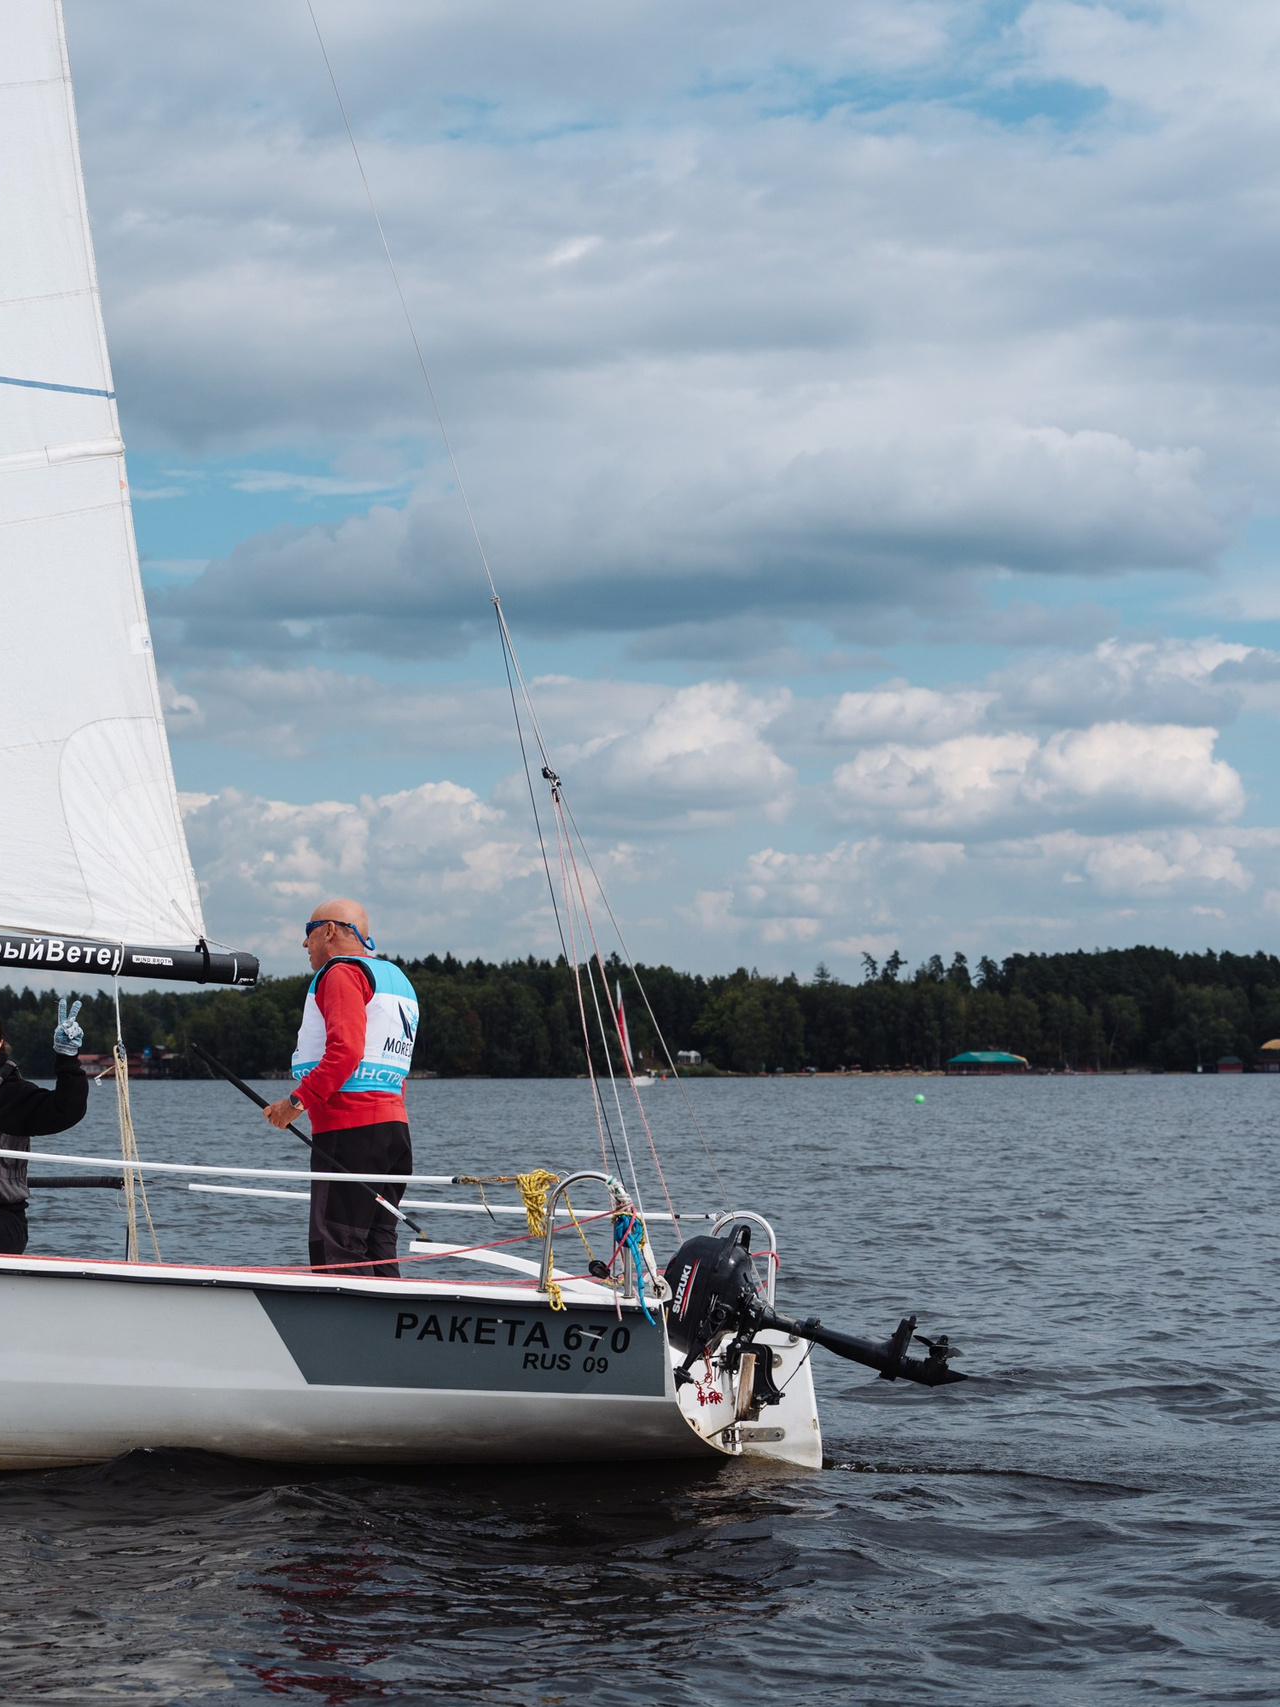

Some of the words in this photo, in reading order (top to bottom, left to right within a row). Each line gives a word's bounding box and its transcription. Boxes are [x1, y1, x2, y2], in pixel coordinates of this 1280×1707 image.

[672, 1264, 692, 1314] SUZUKI
[395, 1313, 550, 1349] РАКЕТА
[563, 1323, 631, 1354] 670
[522, 1353, 571, 1371] RUS
[582, 1356, 609, 1374] 09
